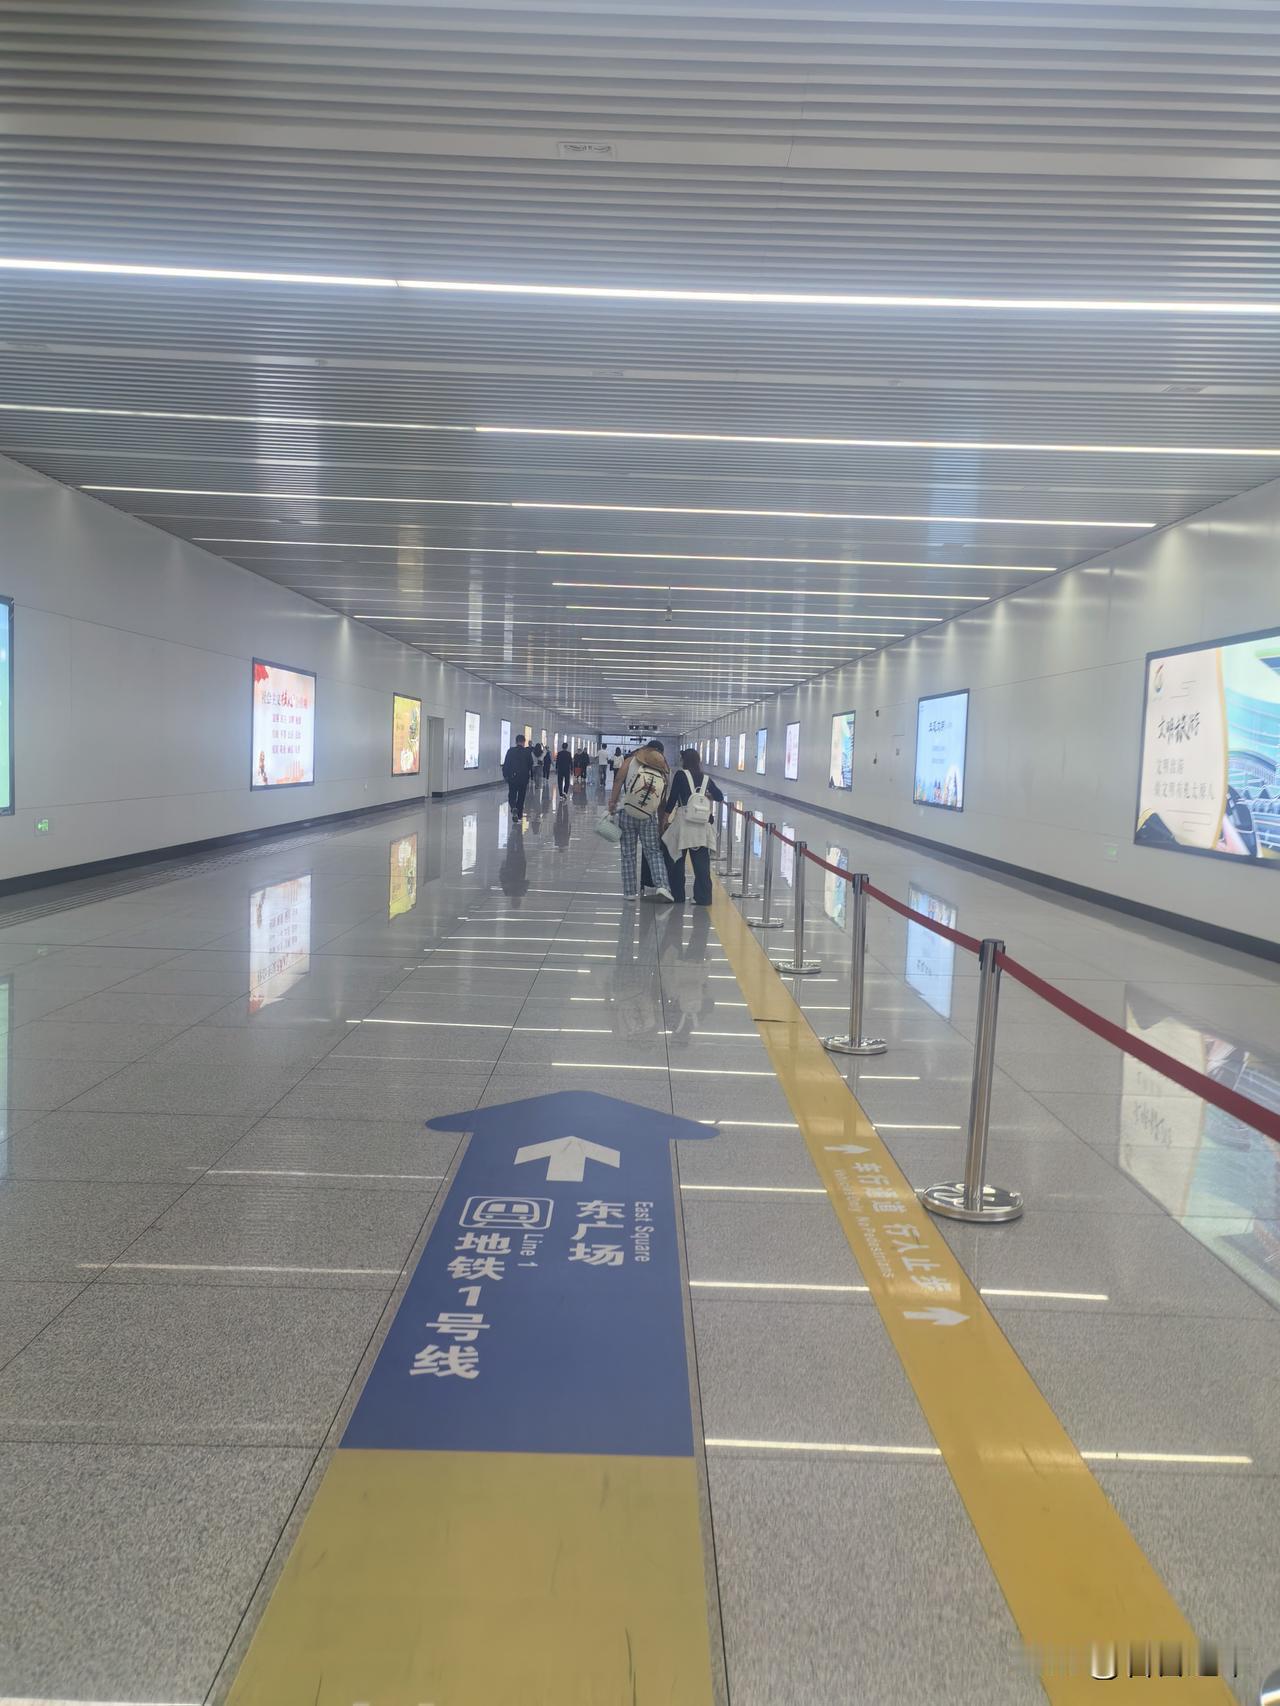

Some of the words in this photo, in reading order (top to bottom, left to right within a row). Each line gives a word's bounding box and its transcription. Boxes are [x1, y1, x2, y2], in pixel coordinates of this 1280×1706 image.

[568, 1200, 625, 1266] 东广场
[634, 1201, 654, 1223] East
[520, 1233, 544, 1257] Line
[629, 1225, 655, 1263] Square
[883, 1223, 953, 1292] 行人止步
[409, 1233, 511, 1379] 地铁1号线
